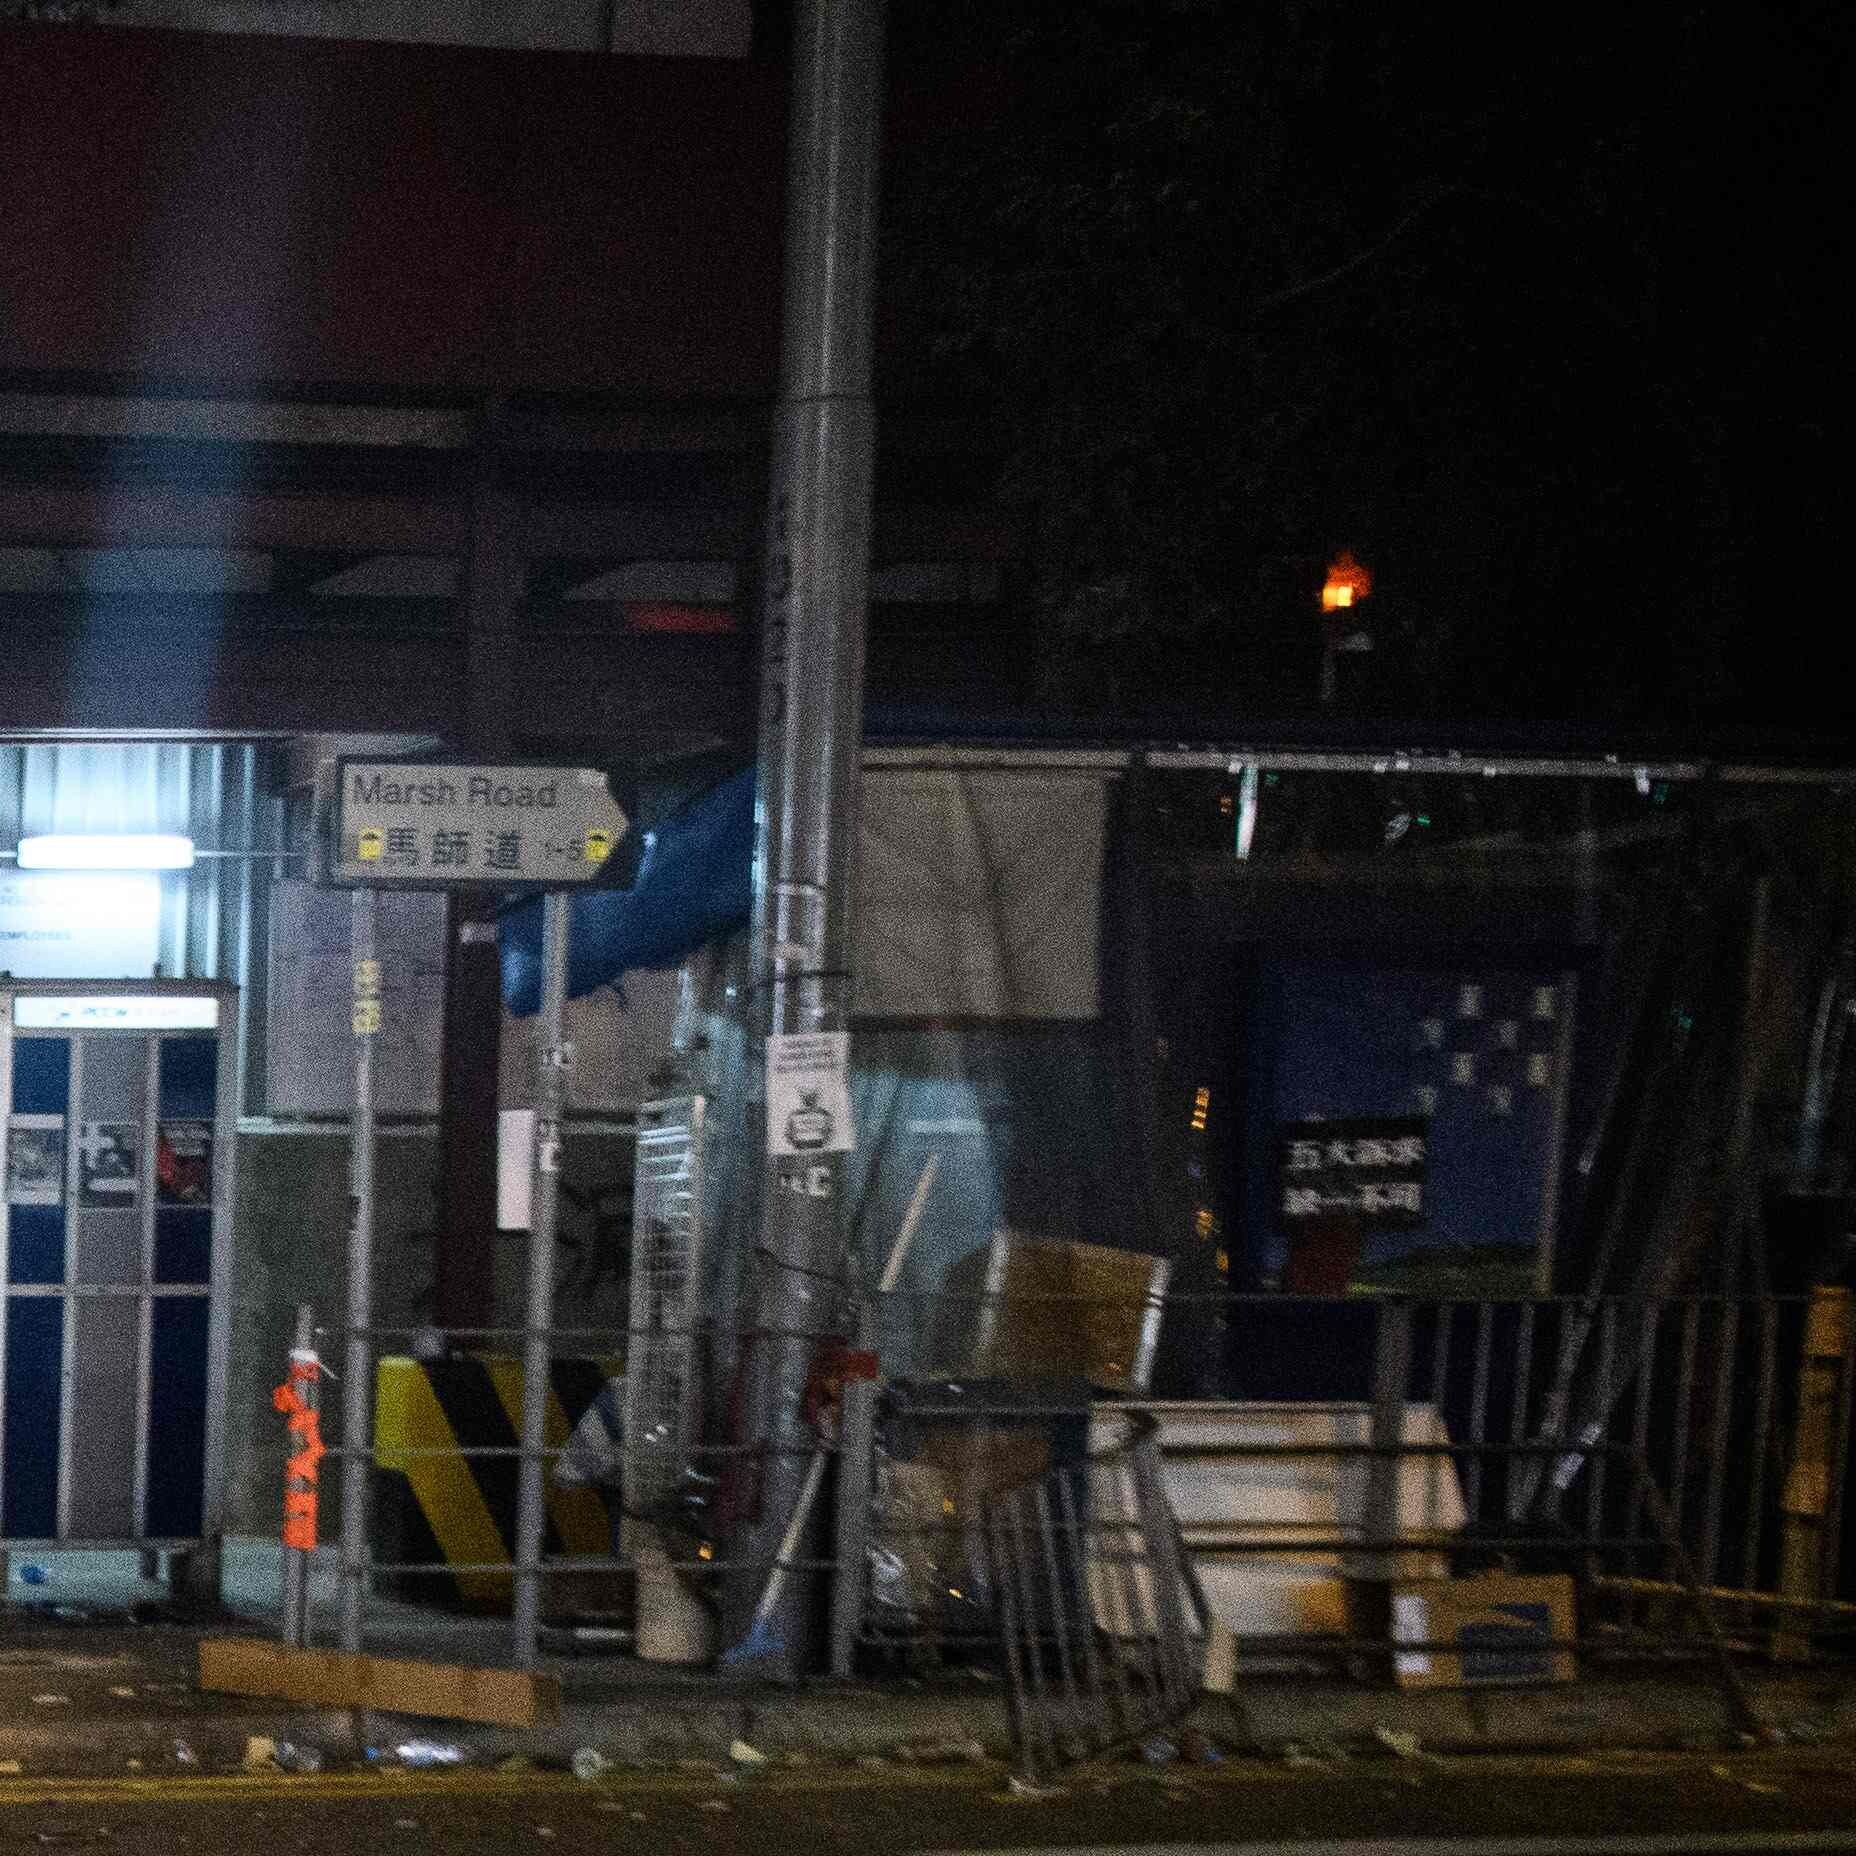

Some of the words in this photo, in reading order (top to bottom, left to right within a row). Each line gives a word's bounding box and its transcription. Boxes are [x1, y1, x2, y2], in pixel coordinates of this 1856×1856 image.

[353, 774, 458, 805] Marsh
[467, 776, 558, 808] Road
[384, 827, 524, 870] 馬師道
